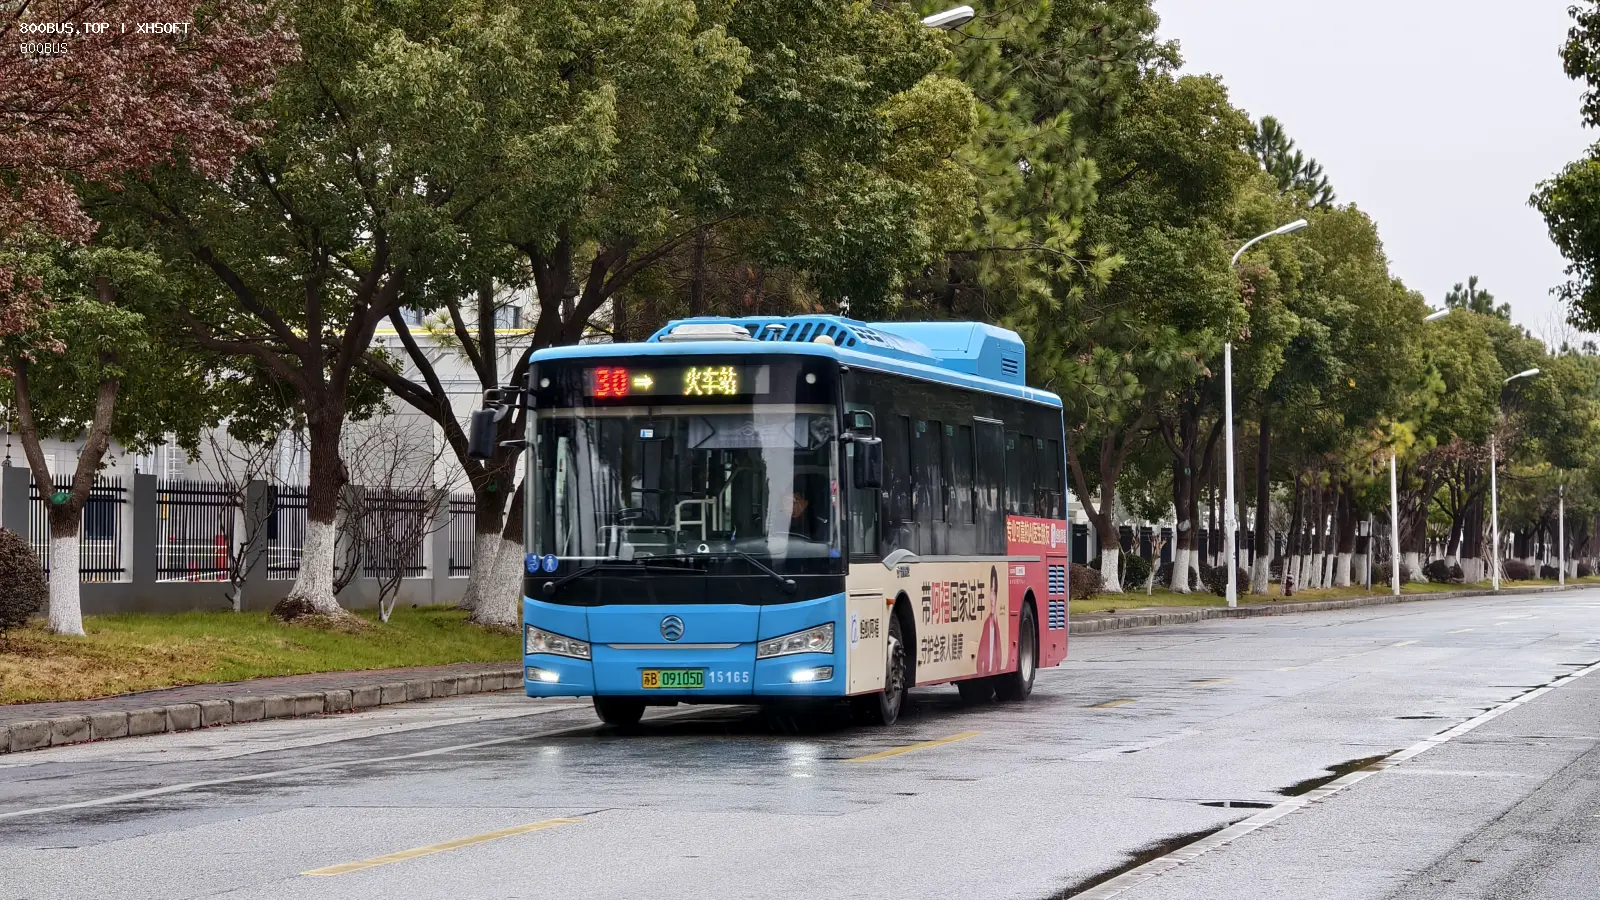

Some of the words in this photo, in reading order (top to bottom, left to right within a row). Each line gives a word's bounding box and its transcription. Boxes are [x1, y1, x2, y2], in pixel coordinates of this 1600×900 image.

[595, 367, 629, 396] 30
[683, 366, 737, 396] 火车站
[921, 579, 985, 625] 带阿福回家过年
[921, 632, 964, 665] 守护全家人健康
[708, 670, 749, 684] 15165
